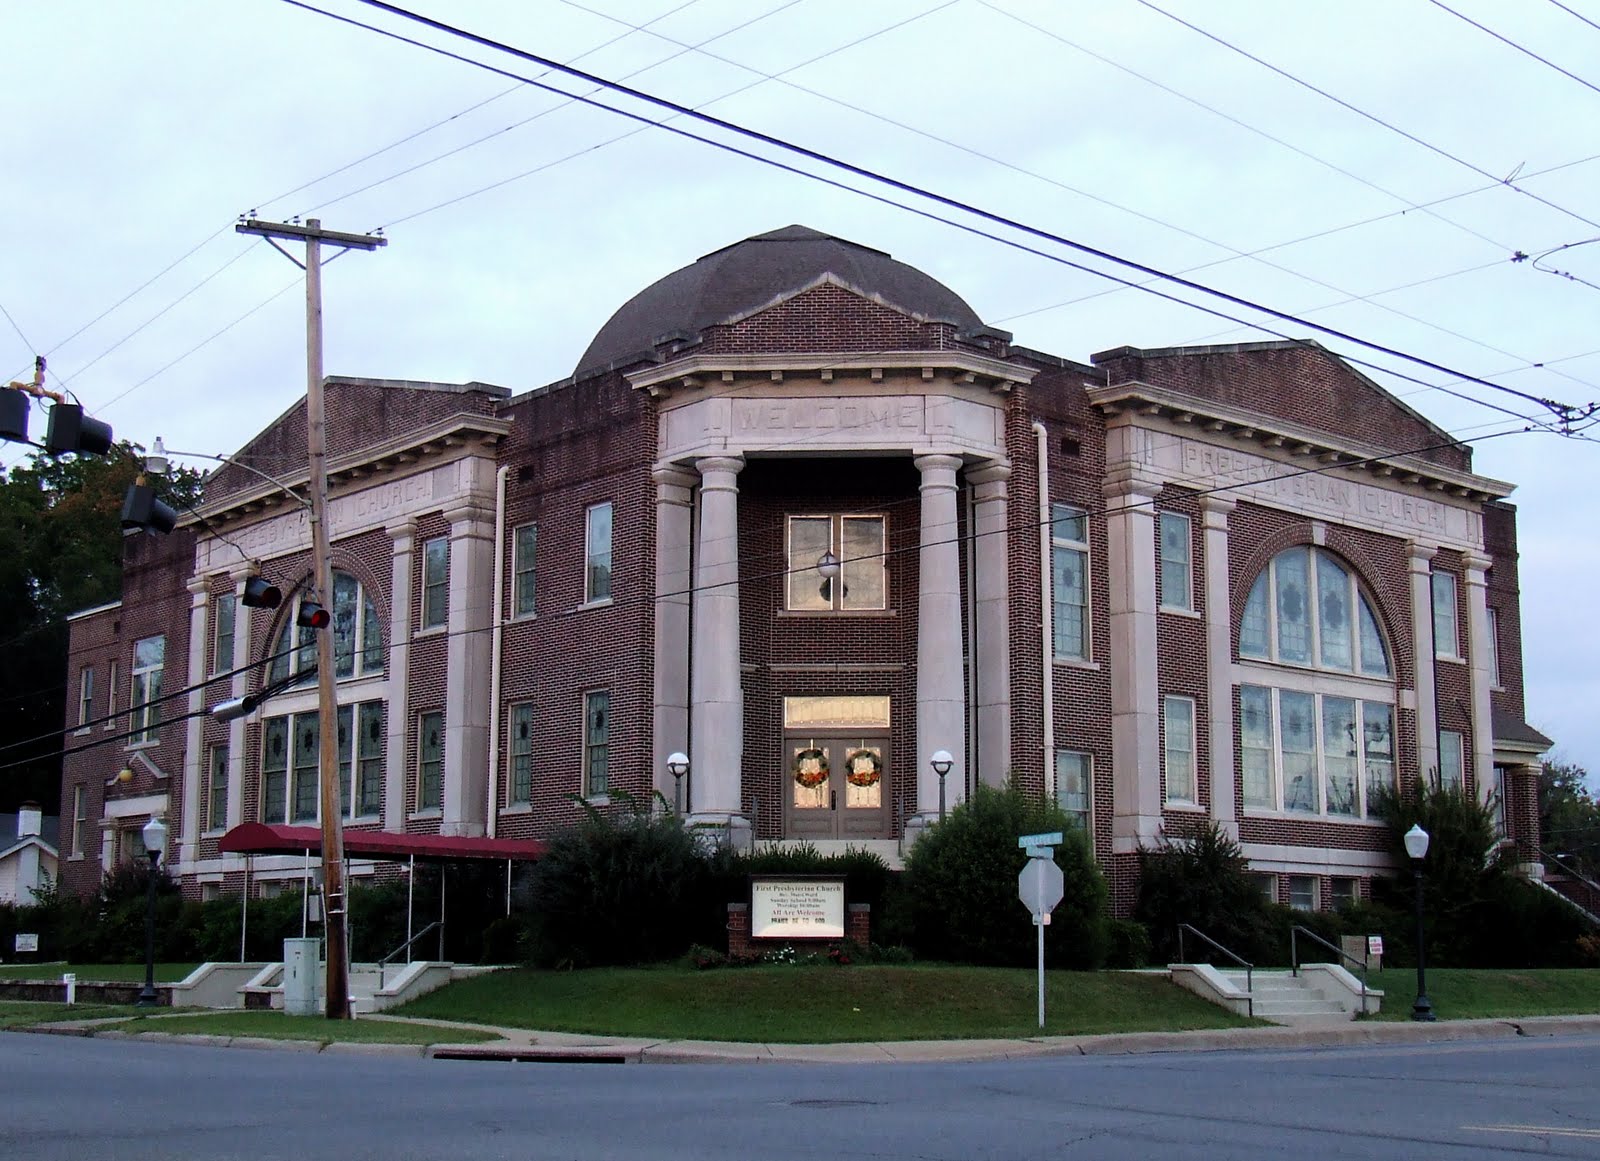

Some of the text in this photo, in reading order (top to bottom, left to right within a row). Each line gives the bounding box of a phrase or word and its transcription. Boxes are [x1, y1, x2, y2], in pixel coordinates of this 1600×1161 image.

[740, 405, 919, 430] WELCOME
[358, 475, 431, 516] CHURCH
[1184, 442, 1445, 530] PRESBYTERIAN CHURCH
[773, 885, 815, 893] Presbyterian
